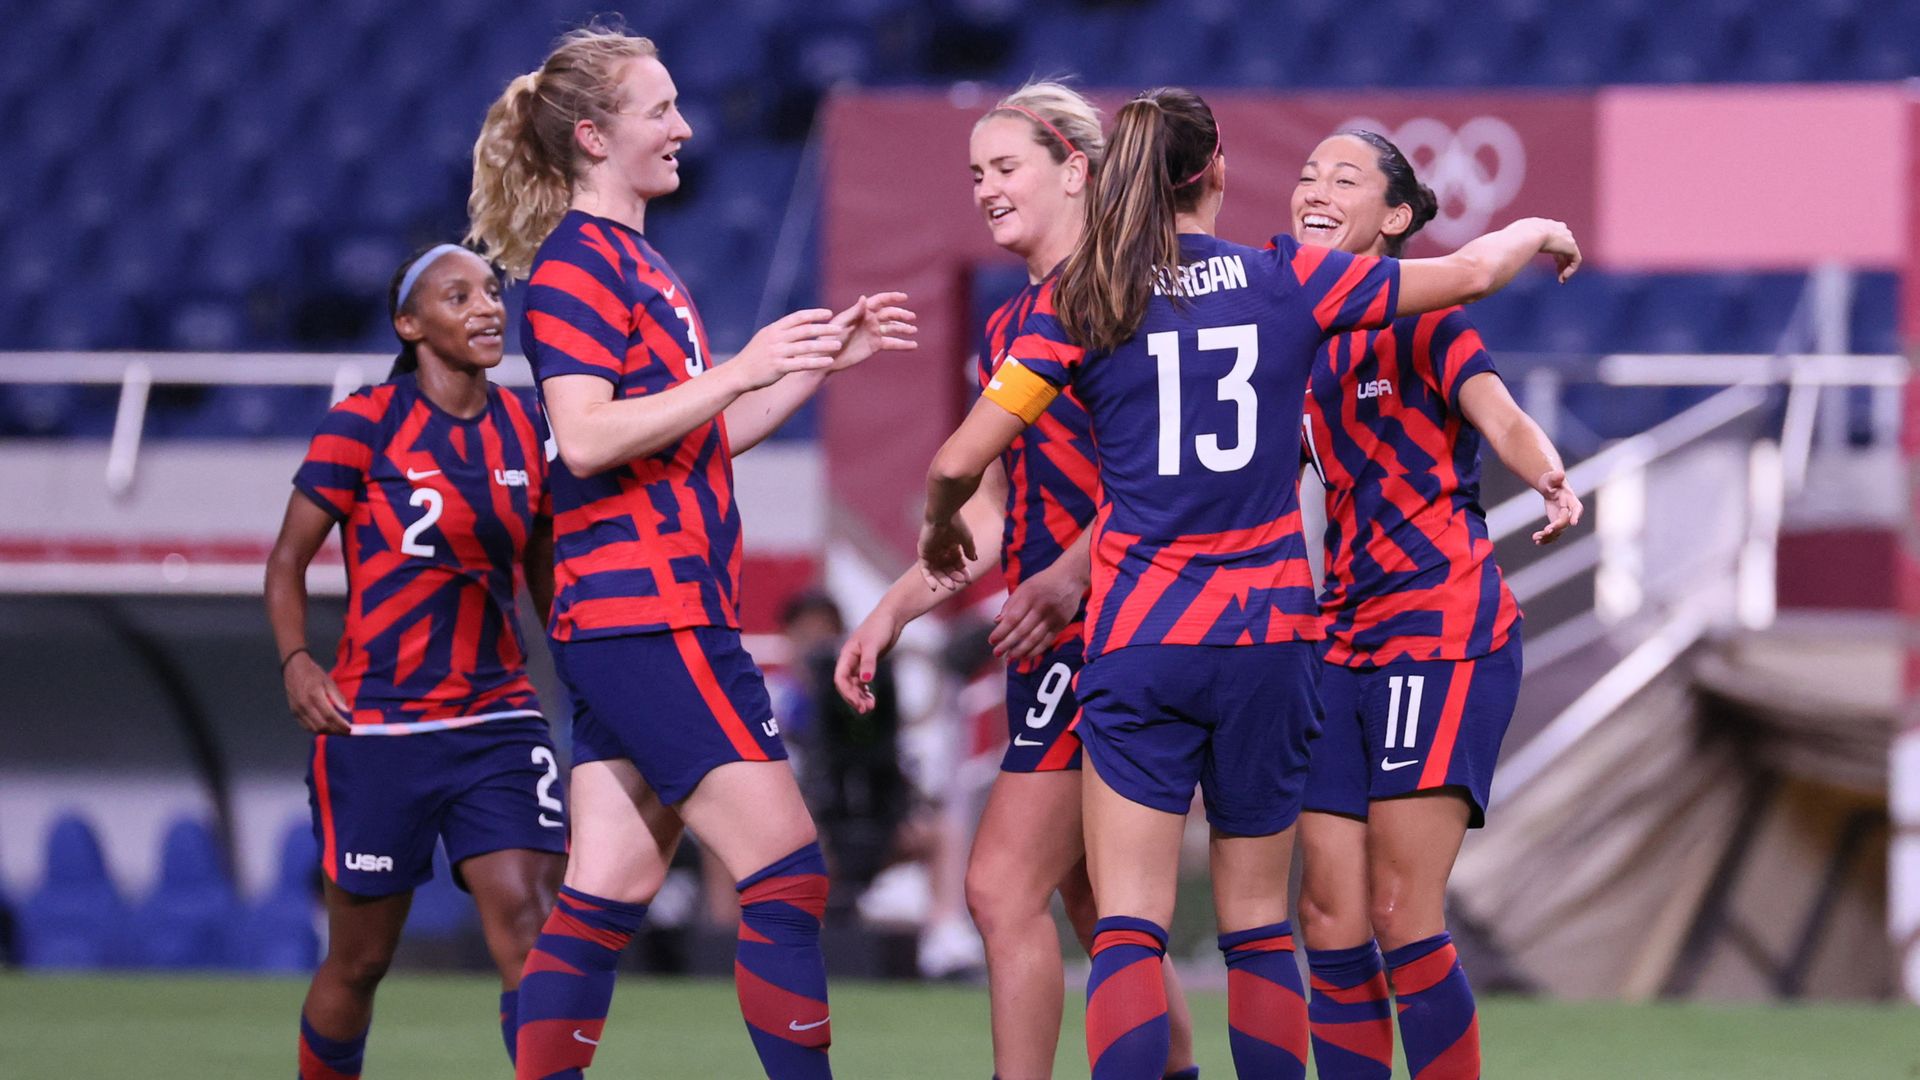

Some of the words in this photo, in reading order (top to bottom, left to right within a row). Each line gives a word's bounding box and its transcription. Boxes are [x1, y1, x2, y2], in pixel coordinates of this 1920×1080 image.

[674, 306, 704, 378] 3
[1147, 323, 1259, 476] 13
[1357, 379, 1393, 400] USA
[494, 468, 530, 487] USA
[401, 487, 444, 558] 2
[1025, 662, 1072, 729] 9
[1384, 675, 1425, 749] 11
[531, 745, 563, 813] 2
[344, 851, 394, 872] USA
